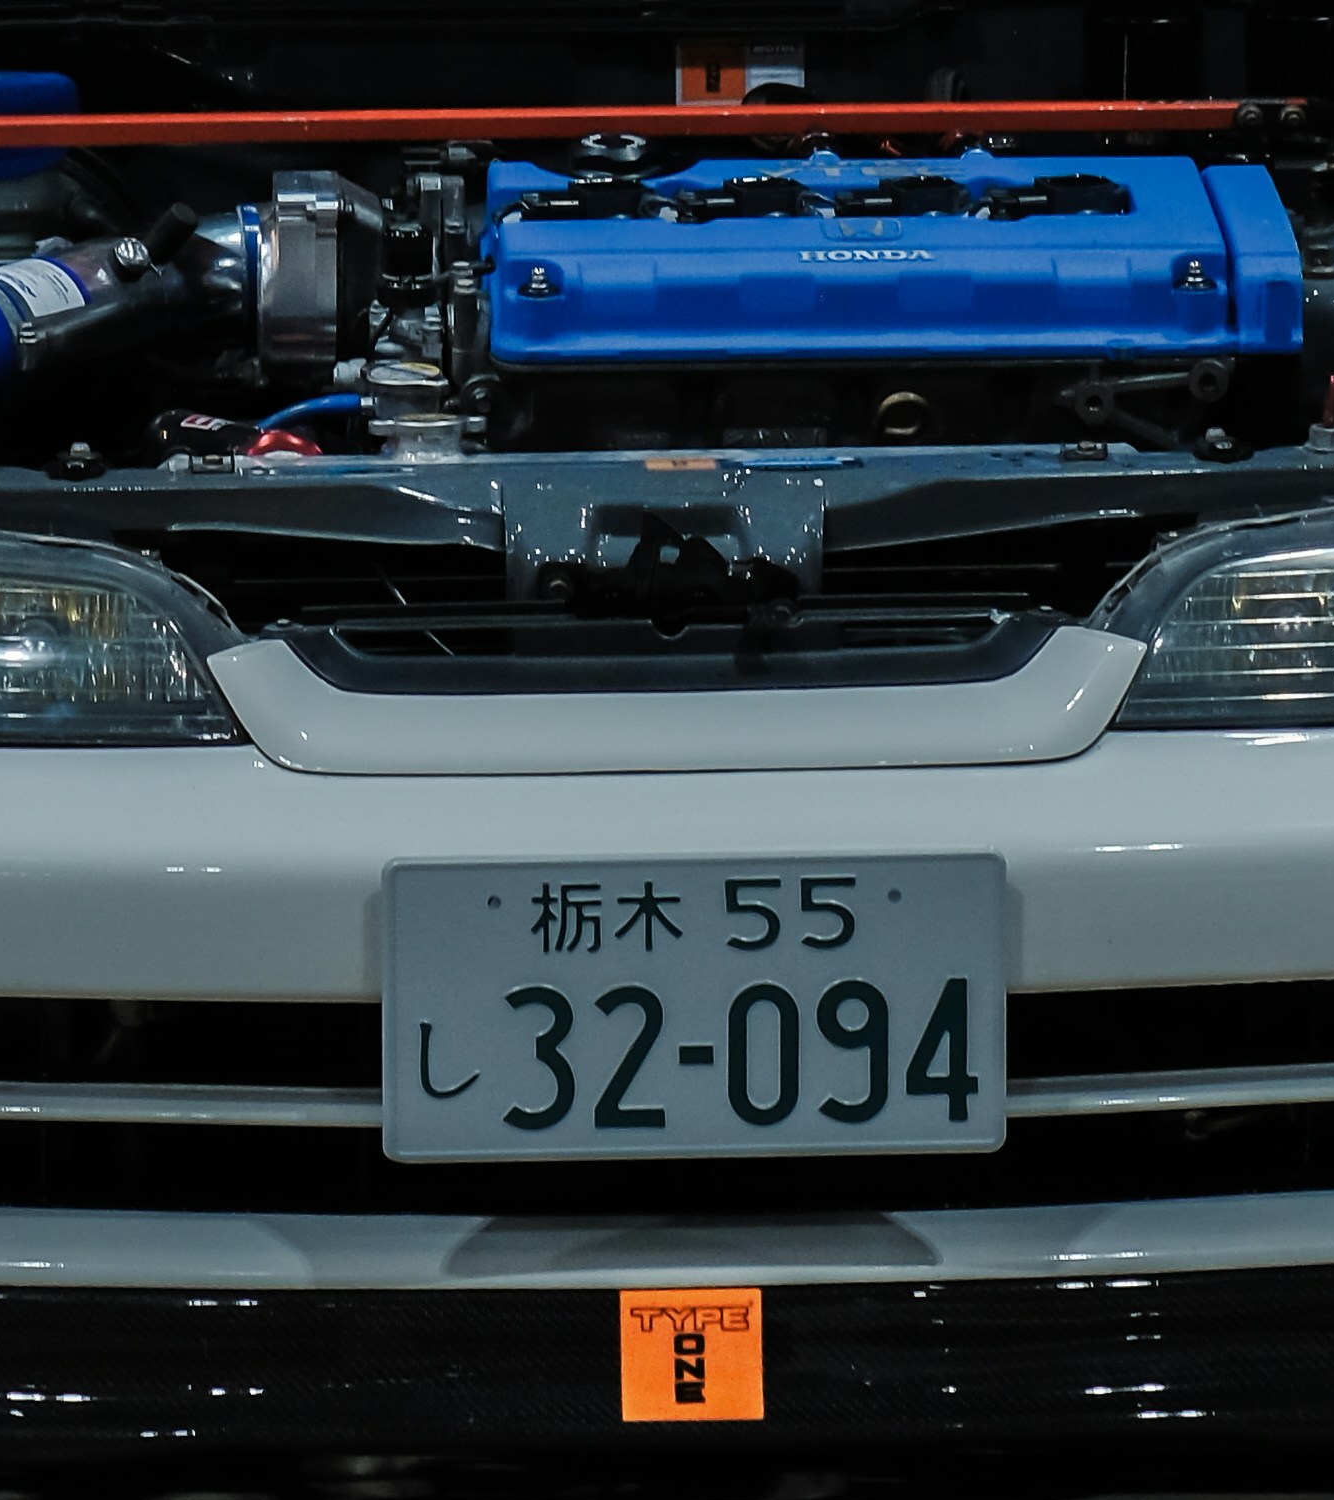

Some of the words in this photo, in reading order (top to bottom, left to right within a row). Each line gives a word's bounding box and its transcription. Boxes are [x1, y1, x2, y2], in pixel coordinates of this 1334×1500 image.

[799, 249, 935, 262] HONDA
[531, 881, 683, 953] 栃木
[724, 876, 857, 951] 55
[419, 1021, 480, 1098] し
[503, 978, 979, 1131] 32-094
[630, 1305, 750, 1333] TYPE
[673, 1333, 706, 1403] ONE
